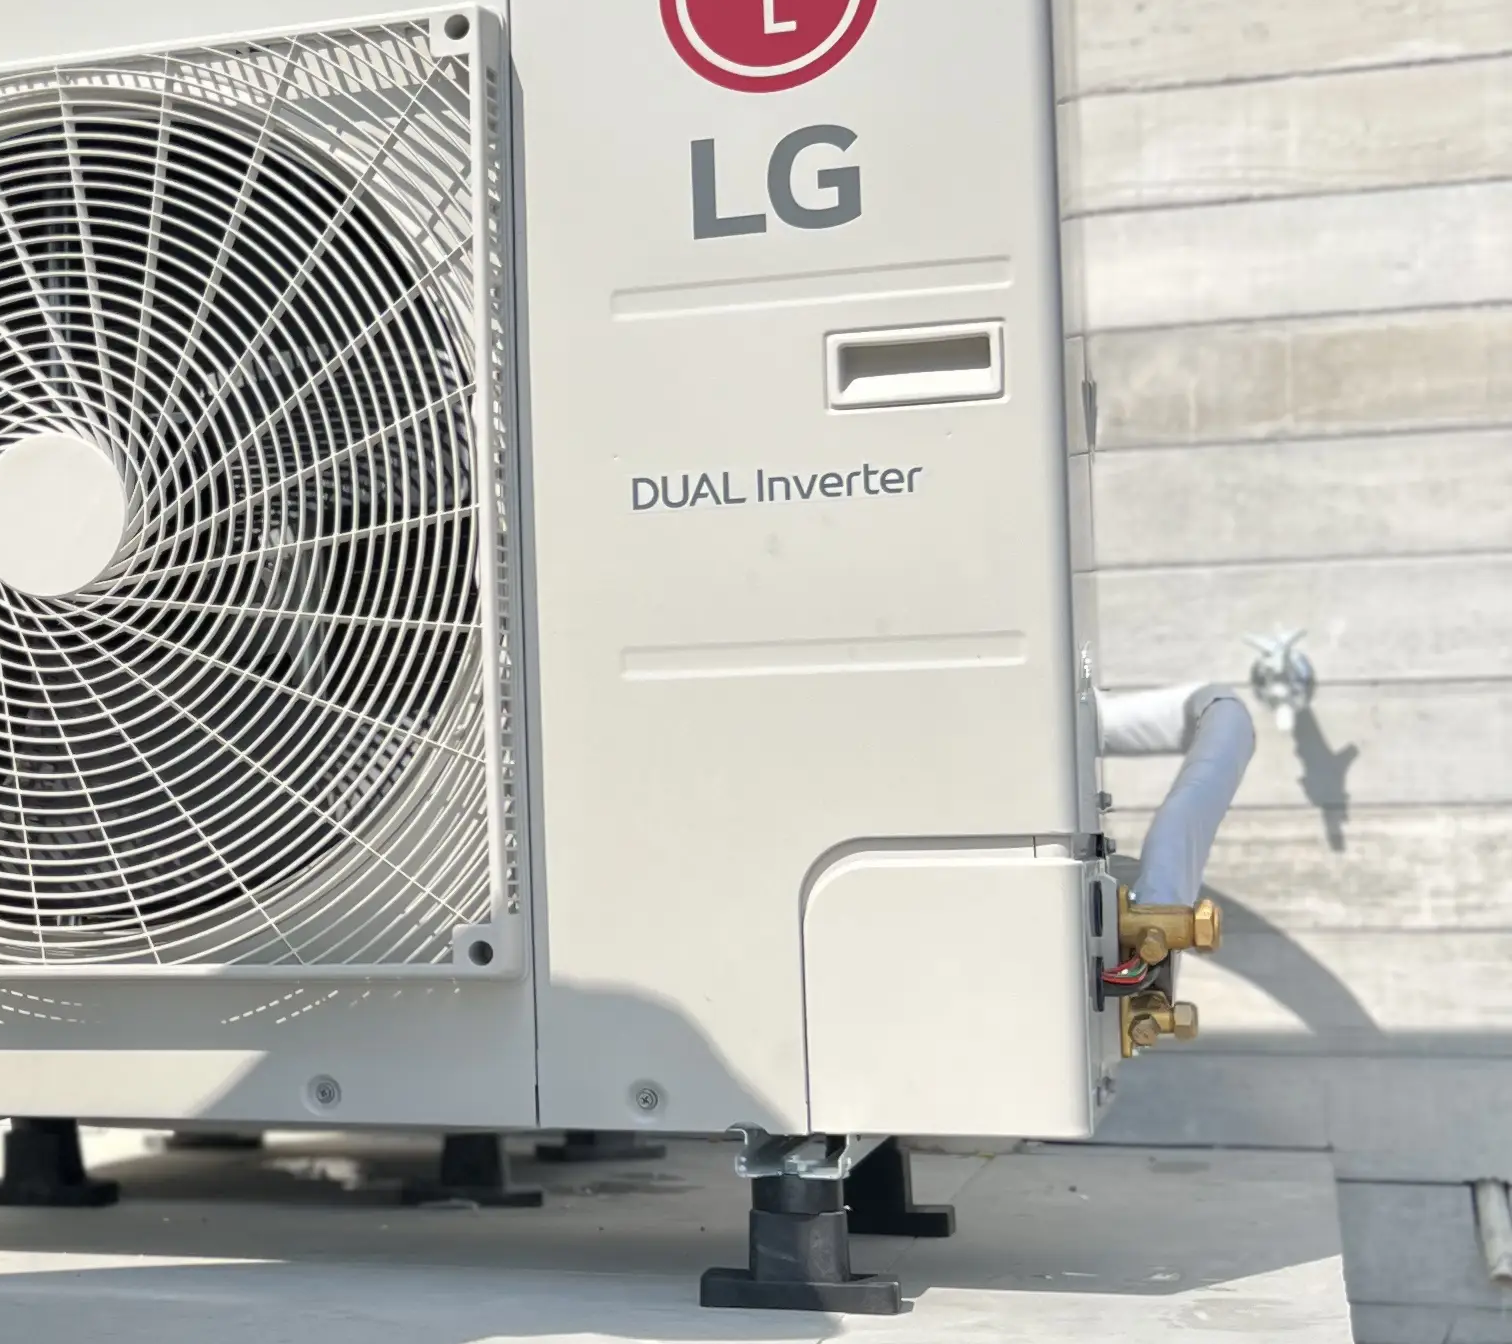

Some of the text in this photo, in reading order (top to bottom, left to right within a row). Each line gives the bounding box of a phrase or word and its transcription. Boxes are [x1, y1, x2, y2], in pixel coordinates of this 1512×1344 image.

[690, 123, 863, 241] LG
[632, 463, 923, 511] DUAL Inverter
